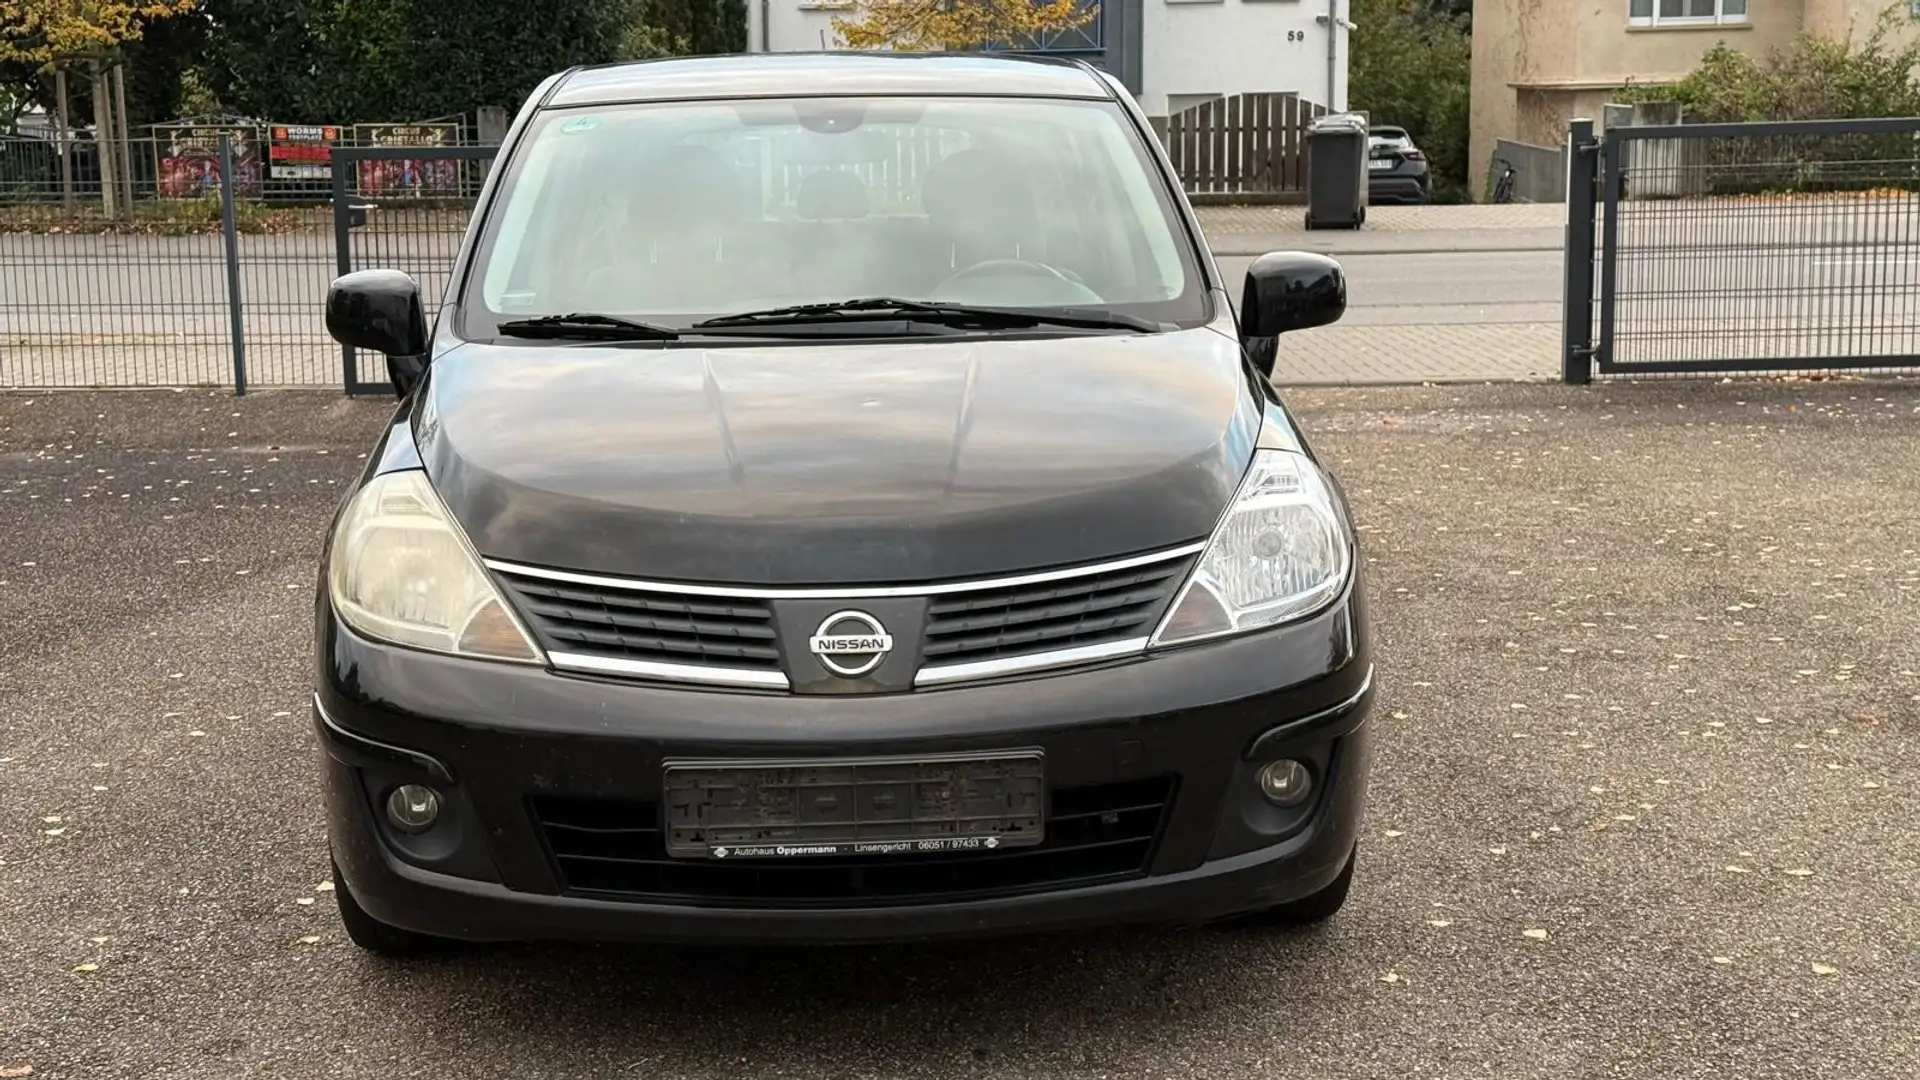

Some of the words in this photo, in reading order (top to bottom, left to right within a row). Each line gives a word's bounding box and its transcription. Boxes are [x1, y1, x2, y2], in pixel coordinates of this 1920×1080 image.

[1287, 30, 1304, 42] 59
[287, 127, 323, 135] WORMS
[392, 127, 420, 135] CIRCUS
[818, 638, 885, 650] NISSAN
[733, 847, 775, 856] Autohaus
[776, 845, 837, 856] Oppermann
[854, 842, 911, 853] Linsengericht
[918, 841, 944, 850] 06051
[952, 838, 980, 848] 97433
